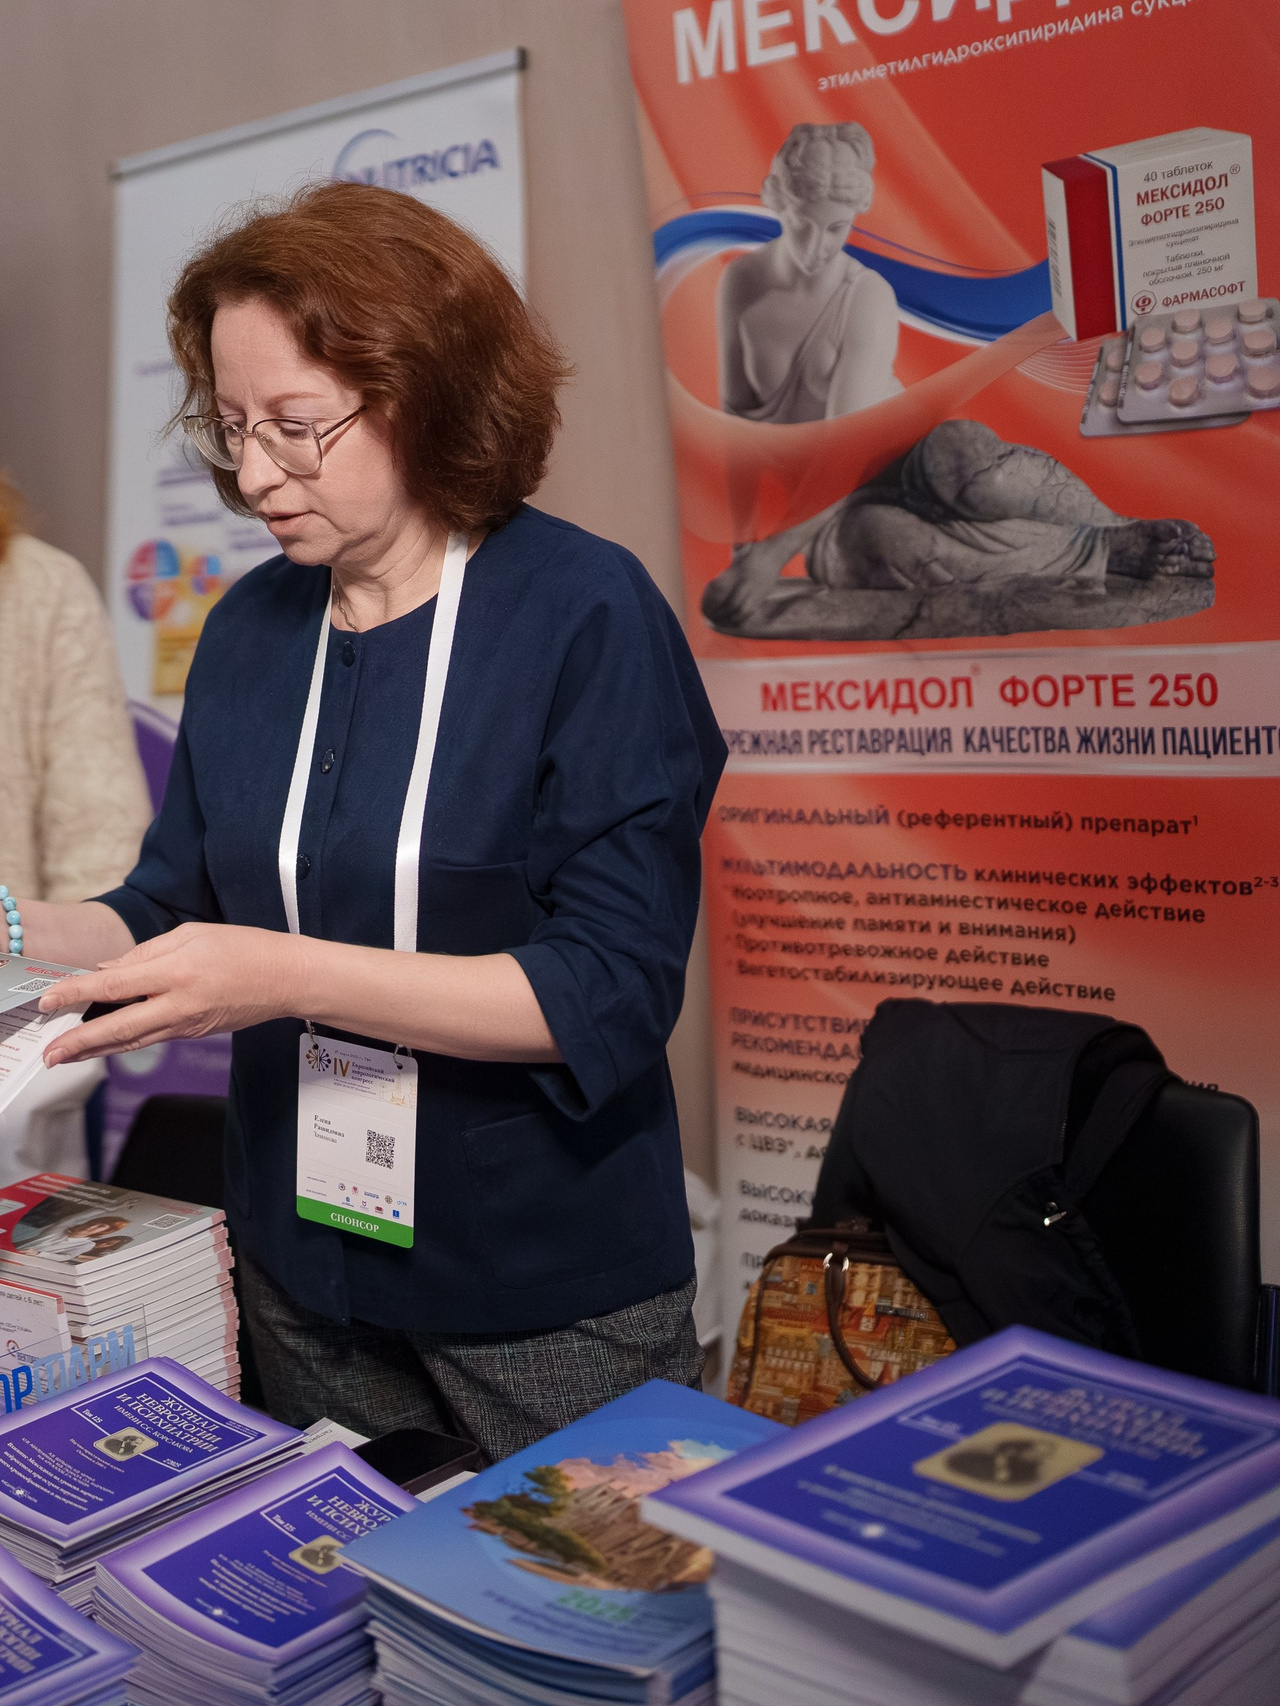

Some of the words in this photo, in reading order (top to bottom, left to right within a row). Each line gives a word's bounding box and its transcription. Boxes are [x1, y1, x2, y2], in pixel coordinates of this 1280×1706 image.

[818, 3, 1124, 92] этилметилгидроксипиридина
[1143, 171, 1158, 183] 40
[1160, 161, 1213, 181] таблеток
[1140, 203, 1191, 226] ФОРТЕ
[1195, 196, 1225, 216] 250
[1162, 280, 1246, 308] ФАРМАСОФТ
[999, 673, 1136, 708] ФОРТЕ
[1148, 672, 1219, 708] 250
[808, 726, 952, 756] РЕСТАВРАЦИЯ
[963, 726, 1071, 754] КАЧЕСТВА
[1076, 726, 1156, 756] ЖИЗНИ
[1162, 725, 1280, 758] ПАЦИЕНТ
[718, 804, 890, 826] ОРИГИНАЛЬНЫЙ
[897, 809, 1073, 832] (референтный)
[974, 866, 1119, 890] клинических
[866, 889, 1087, 916] антиамнестическое
[1095, 900, 1206, 923] действие
[852, 916, 932, 934] памяти
[938, 920, 952, 935] и
[959, 920, 1076, 944] внимания)
[945, 944, 1050, 968] действие
[1010, 977, 1116, 1002] действие
[731, 1031, 863, 1061] РЕКОМЕНДА
[333, 1058, 349, 1077] IV
[733, 1061, 849, 1085] медицинско
[330, 1211, 379, 1232] СПОНСОР
[112, 1404, 145, 1424] ИМЕНИ
[114, 1392, 132, 1402] И
[125, 1400, 219, 1452] ПСИХИАТРИИ
[134, 1392, 223, 1443] НЕВРОЛОГИИ
[159, 1396, 220, 1432] ЖУРНАЛ
[305, 1494, 324, 1506] И
[353, 1499, 392, 1523] ЖУР
